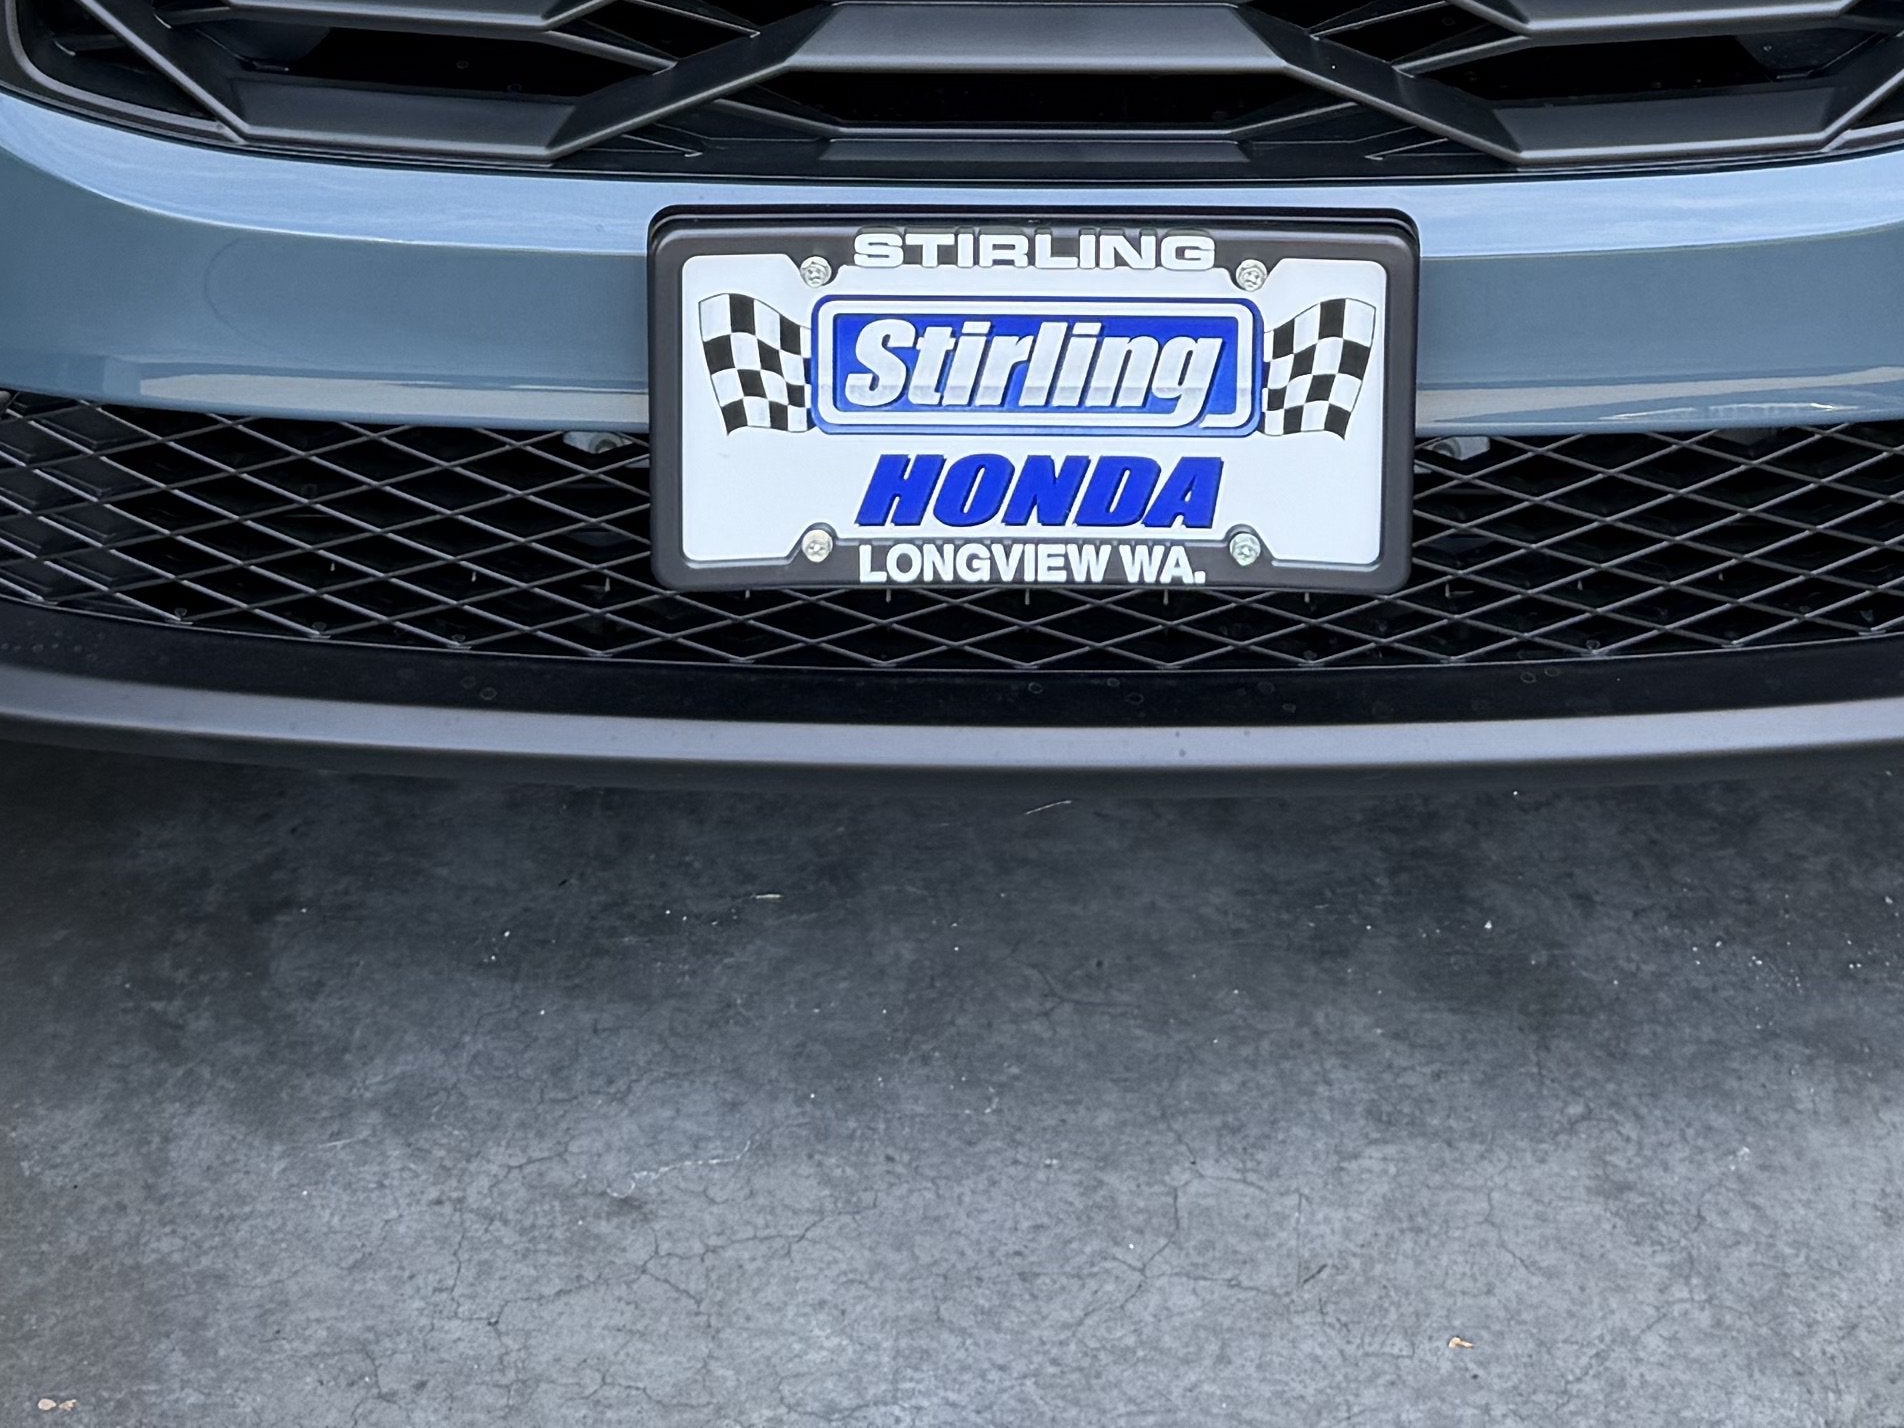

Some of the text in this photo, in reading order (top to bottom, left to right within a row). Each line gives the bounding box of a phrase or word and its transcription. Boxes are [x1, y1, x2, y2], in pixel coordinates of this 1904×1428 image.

[853, 231, 1216, 272] STIRLING
[844, 318, 1224, 428] Stirling
[853, 453, 1225, 529] HONDA
[858, 542, 1208, 585] LONGVIEW WA.
